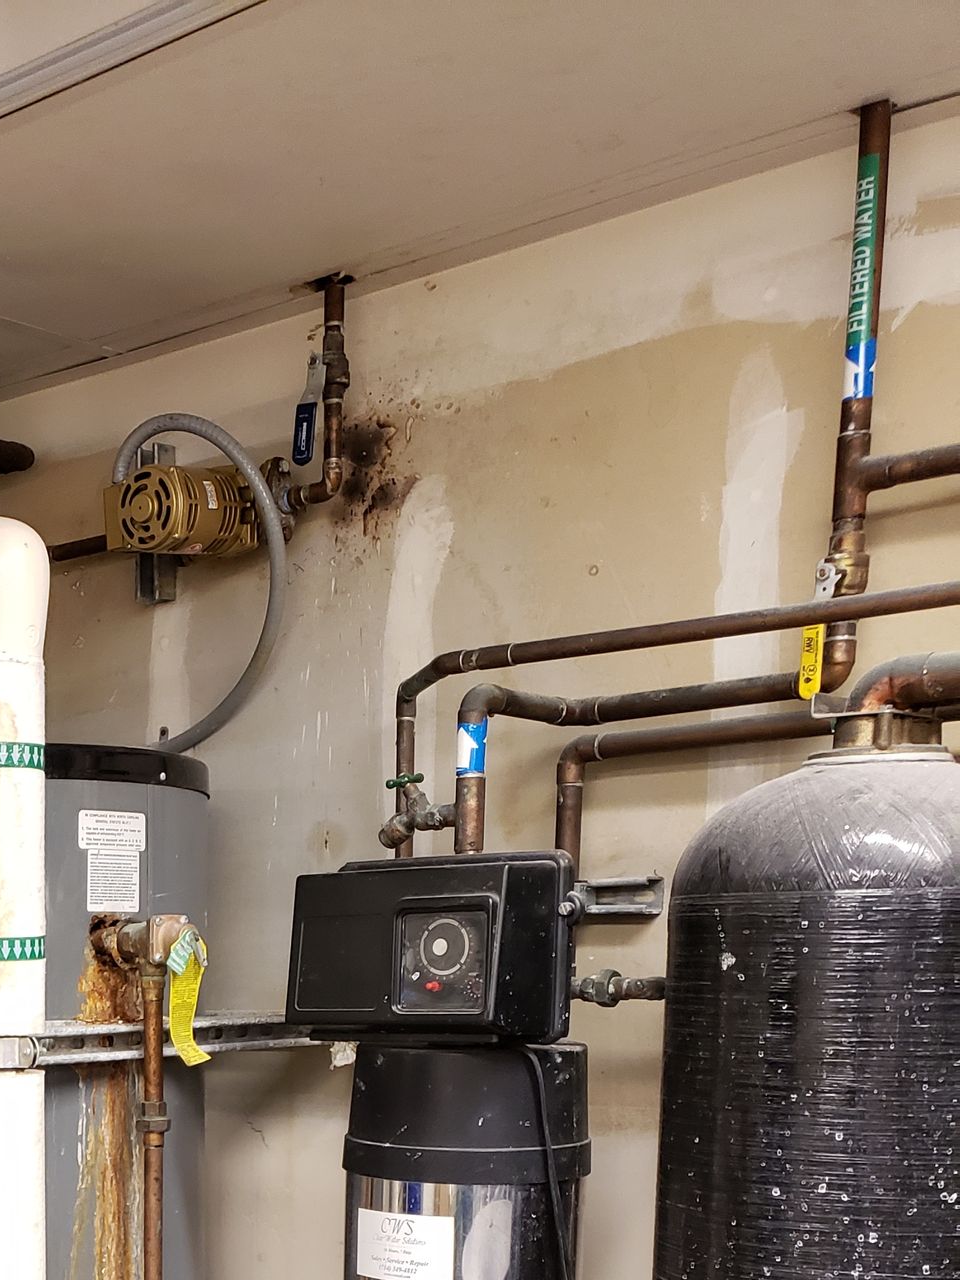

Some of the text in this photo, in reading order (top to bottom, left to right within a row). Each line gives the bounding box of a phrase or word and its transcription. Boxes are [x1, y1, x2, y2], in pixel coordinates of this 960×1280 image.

[847, 176, 875, 334] FILTERED WATER
[381, 1217, 415, 1235] CWS
